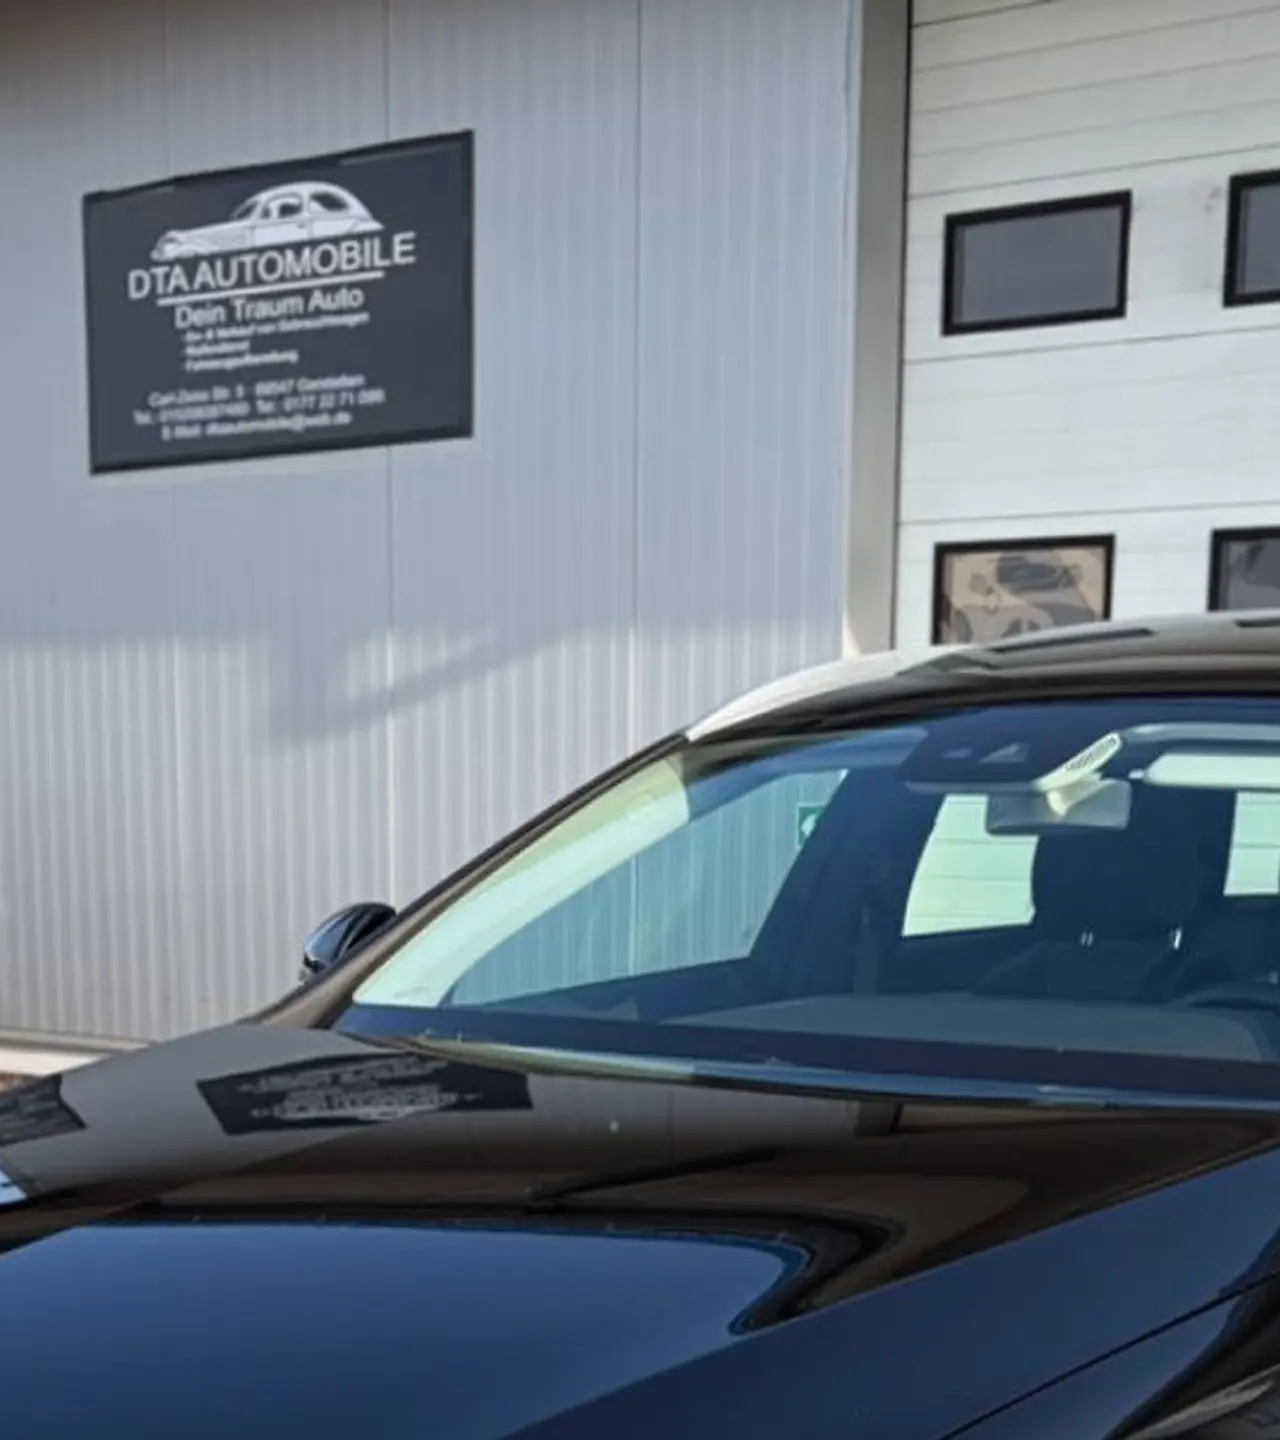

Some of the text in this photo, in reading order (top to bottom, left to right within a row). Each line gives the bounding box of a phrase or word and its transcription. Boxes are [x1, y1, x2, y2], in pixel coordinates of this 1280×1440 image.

[127, 231, 417, 300] DTA AUTOMOBILE
[175, 301, 226, 329] Dein
[231, 295, 304, 321] Traum
[308, 286, 366, 312] Auto
